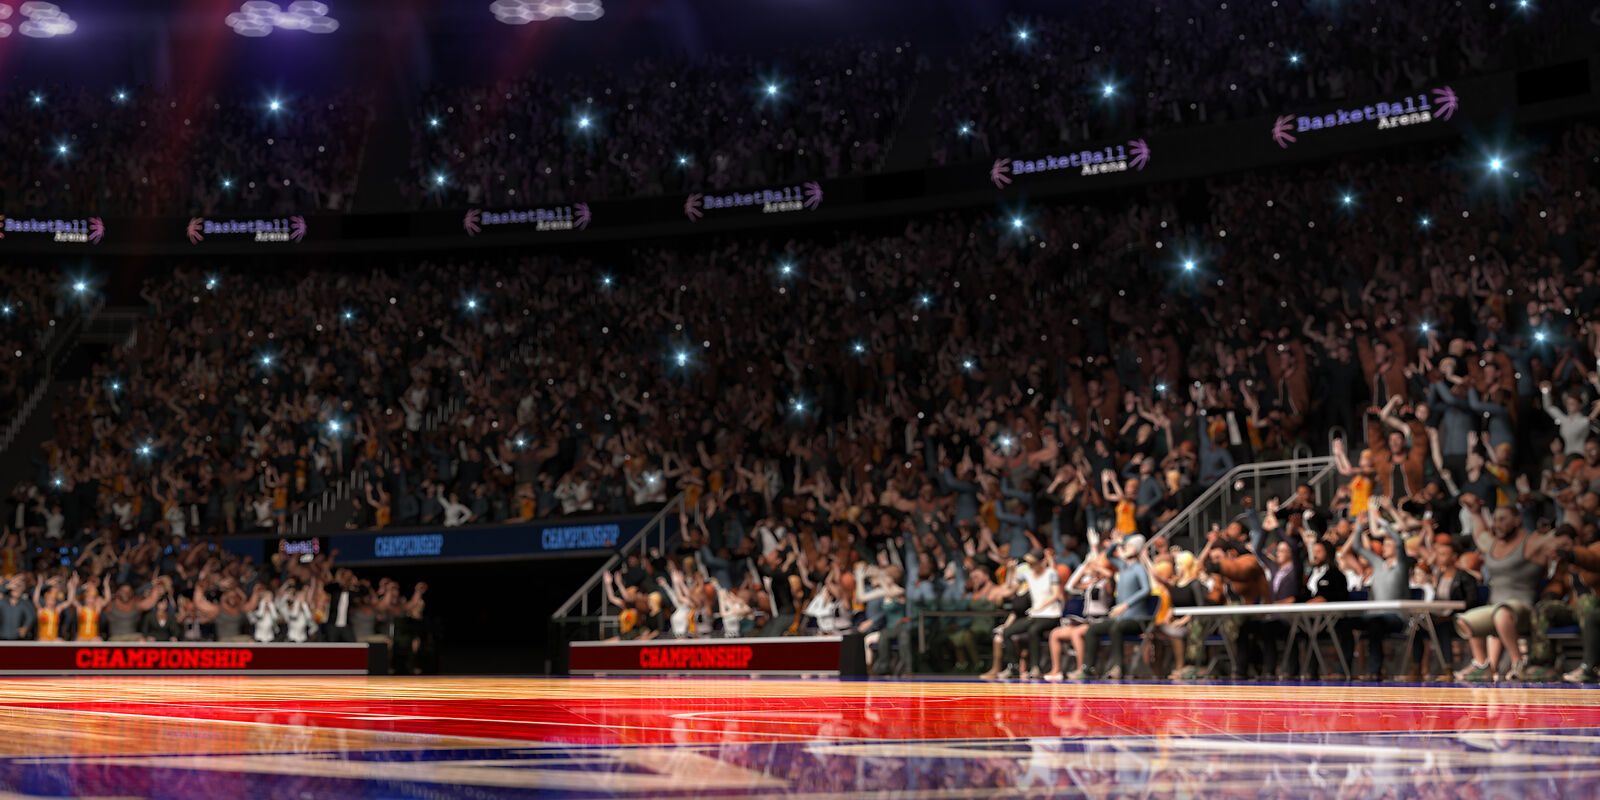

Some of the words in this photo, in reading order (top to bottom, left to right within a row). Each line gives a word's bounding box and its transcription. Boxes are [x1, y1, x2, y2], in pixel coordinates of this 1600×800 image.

[1297, 93, 1431, 133] BasketBall
[1377, 110, 1431, 130] Arena
[1012, 144, 1127, 175] BasketBall
[1081, 160, 1128, 176] Arena
[703, 186, 803, 209] BasketBall
[4, 218, 88, 232] BasketBall
[203, 219, 290, 233] BasketBall
[481, 206, 574, 225] BasketBall
[375, 534, 443, 558] CHAMPIONSHIP
[542, 524, 620, 550] CHAMPIONSHIP
[75, 648, 253, 668] CHAMPIONSHIP
[640, 646, 753, 669] CHAMPIONSHIP
